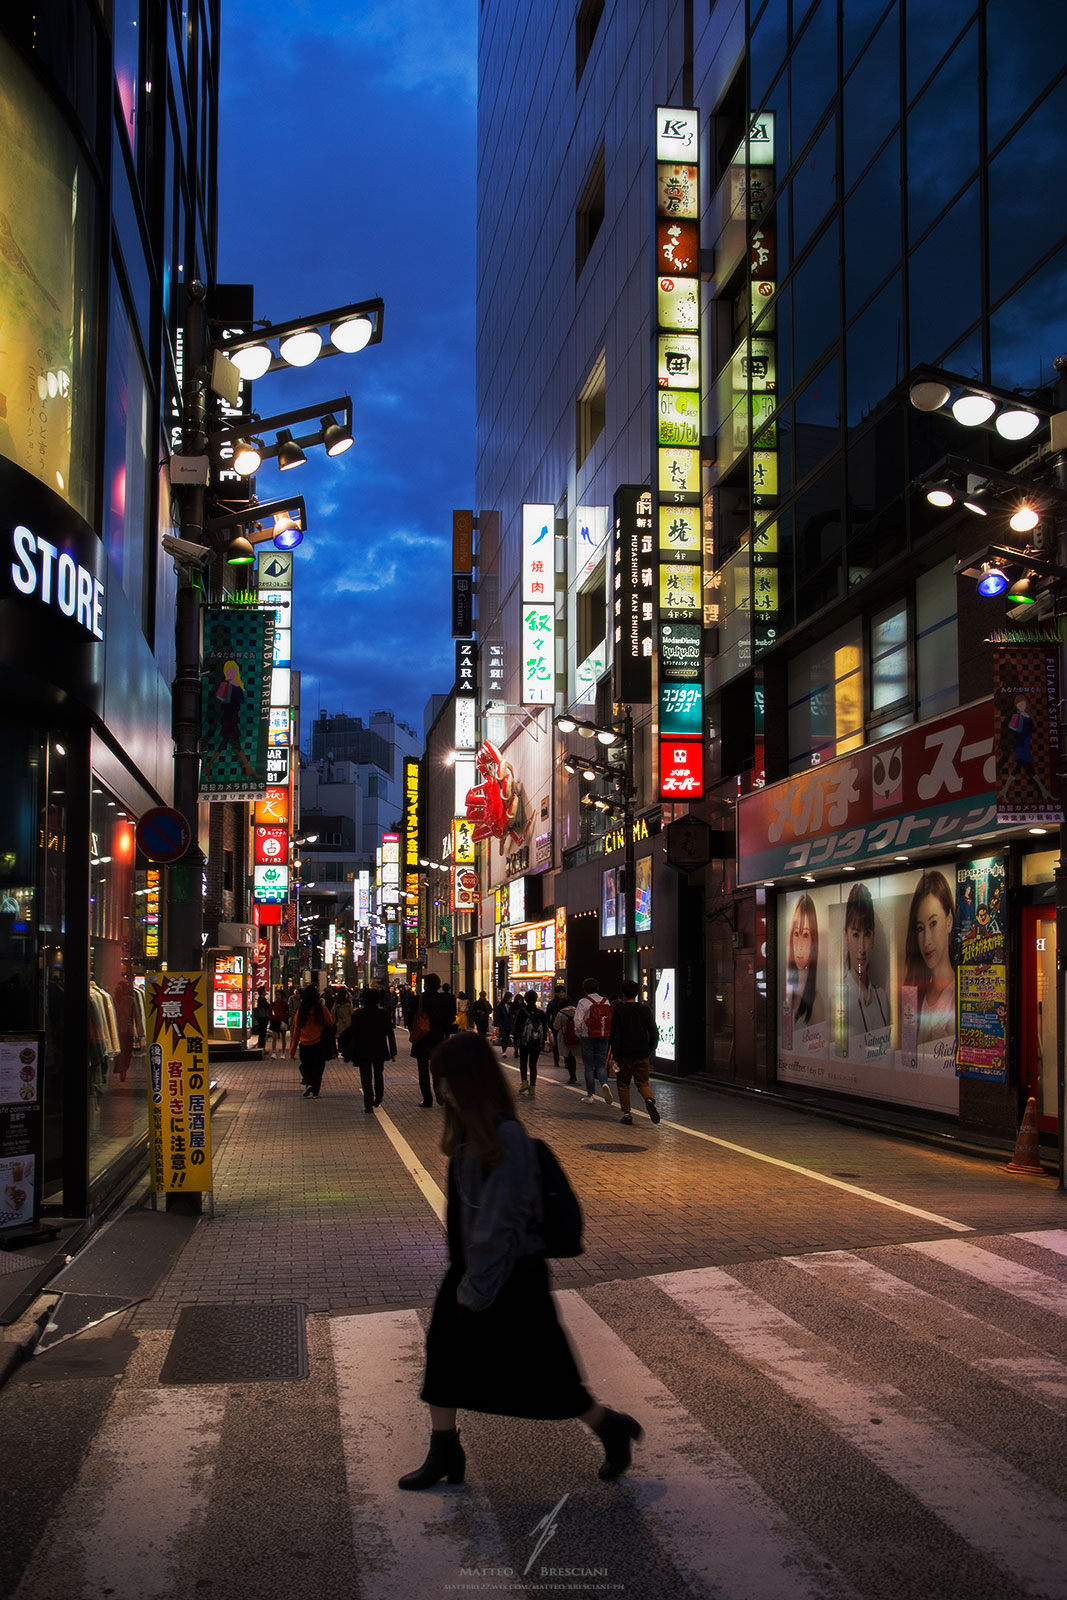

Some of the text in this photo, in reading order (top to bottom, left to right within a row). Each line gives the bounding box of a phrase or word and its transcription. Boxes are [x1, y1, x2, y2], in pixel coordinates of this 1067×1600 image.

[661, 393, 673, 414] 6F
[674, 493, 686, 502] 5F
[674, 551, 686, 560] 4F
[11, 525, 105, 641] STORE
[531, 561, 544, 594] 焼肉
[524, 610, 552, 681] 叙々苑
[630, 615, 638, 657] SHINJUKU
[260, 619, 274, 721] FUTABA STREET
[460, 645, 473, 690] ZARA
[662, 689, 702, 702] コンタクト
[665, 702, 696, 713] レンズ
[1045, 658, 1060, 750] FUTABA STREET
[267, 772, 278, 782] B1
[662, 777, 701, 791] スーパー
[262, 801, 283, 817] K
[767, 761, 861, 843] メガネ
[604, 818, 649, 854] CINMA
[254, 889, 288, 899] CAT
[256, 942, 269, 988] カラオケ
[187, 1037, 205, 1166] 路上の居酒屋の
